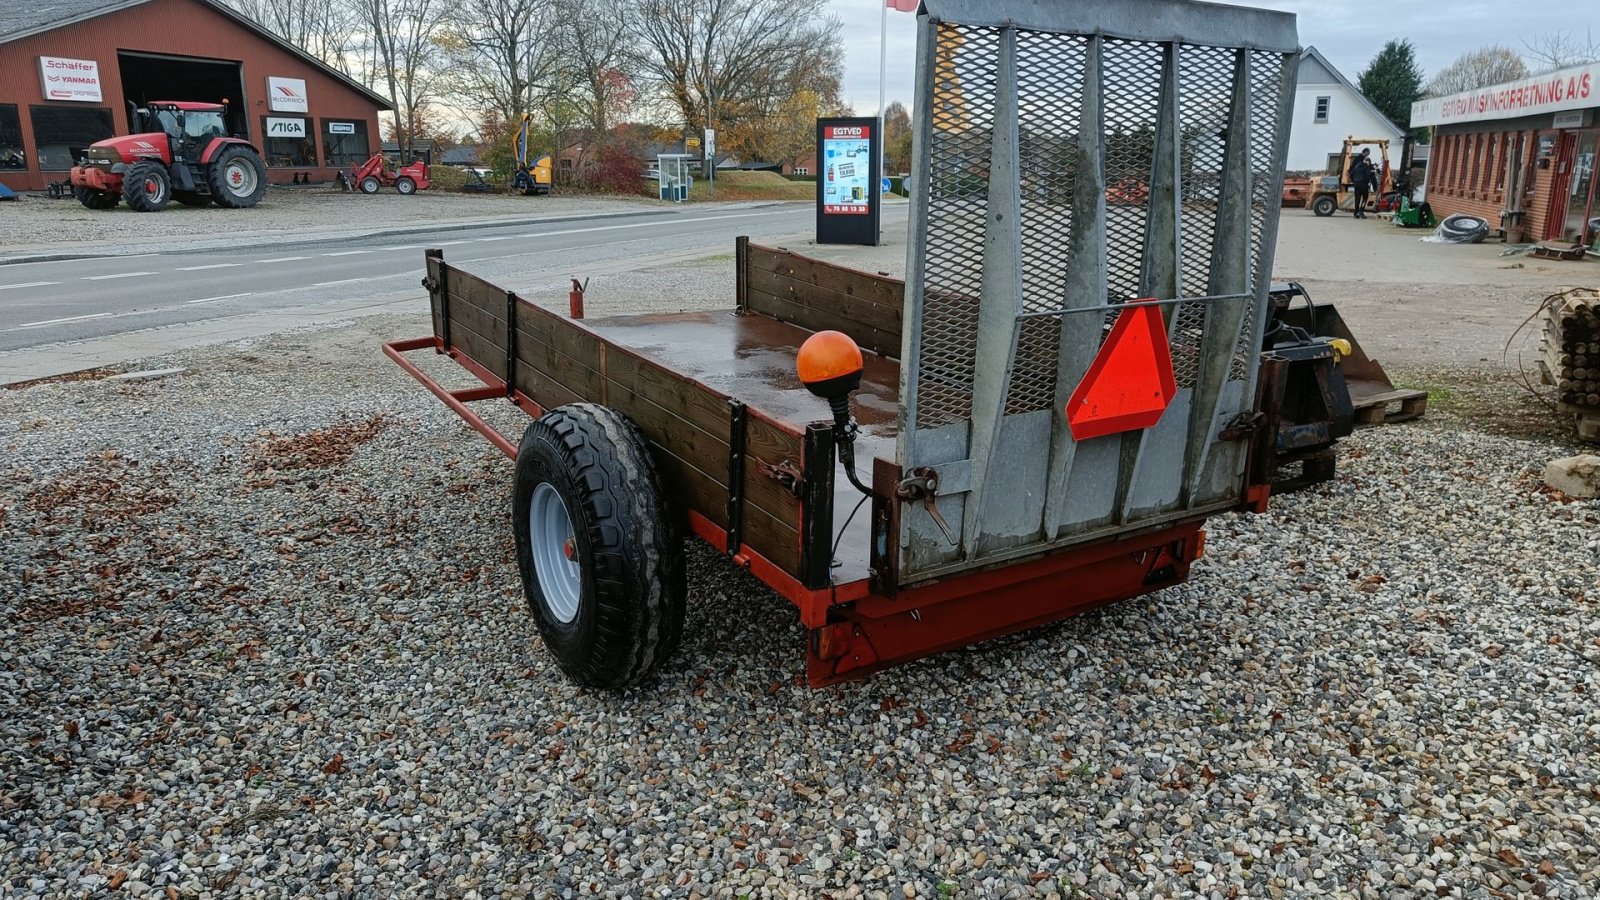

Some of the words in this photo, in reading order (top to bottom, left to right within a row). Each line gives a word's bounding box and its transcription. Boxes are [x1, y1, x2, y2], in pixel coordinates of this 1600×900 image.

[46, 60, 94, 71] Schäffer
[61, 76, 97, 84] YANMAR
[1467, 78, 1563, 114] MASKINFORRETNING
[1566, 73, 1591, 100] A/S
[271, 122, 302, 132] STIGA
[833, 127, 862, 135] EGTVED
